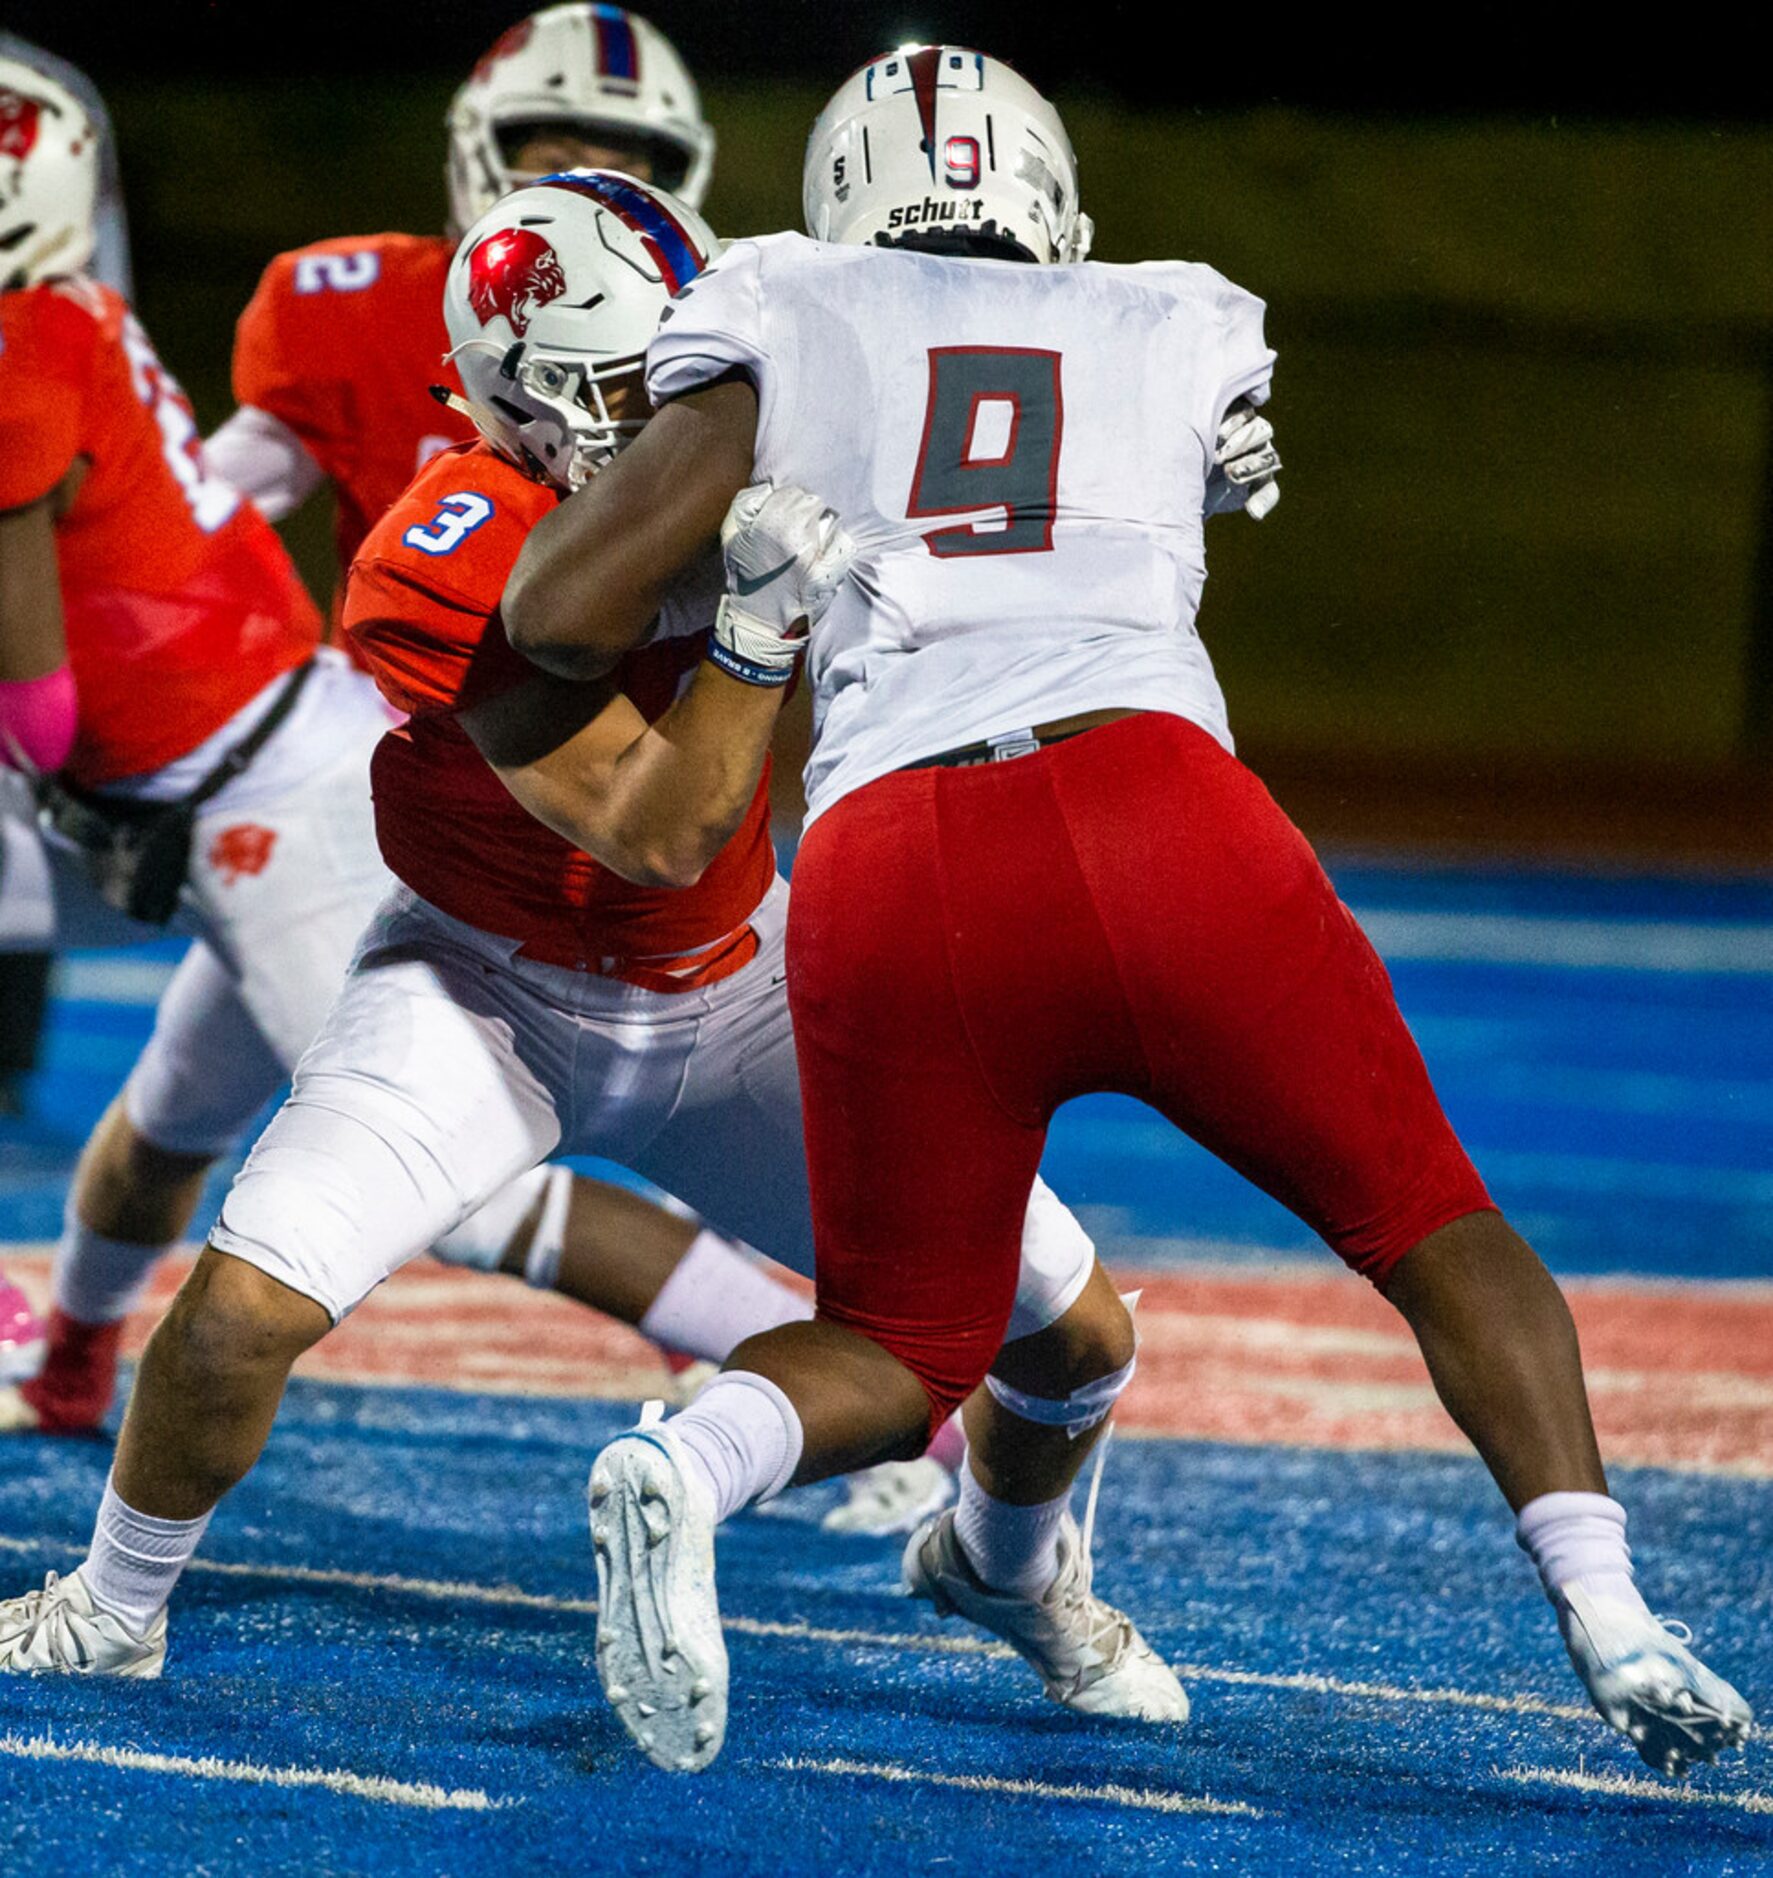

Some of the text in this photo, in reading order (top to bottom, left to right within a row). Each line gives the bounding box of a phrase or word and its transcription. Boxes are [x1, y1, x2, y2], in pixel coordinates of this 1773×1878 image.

[944, 135, 981, 190] 9
[887, 196, 984, 230] schutt
[294, 250, 381, 295] 2
[905, 345, 1063, 558] 9
[403, 490, 496, 557] 3
